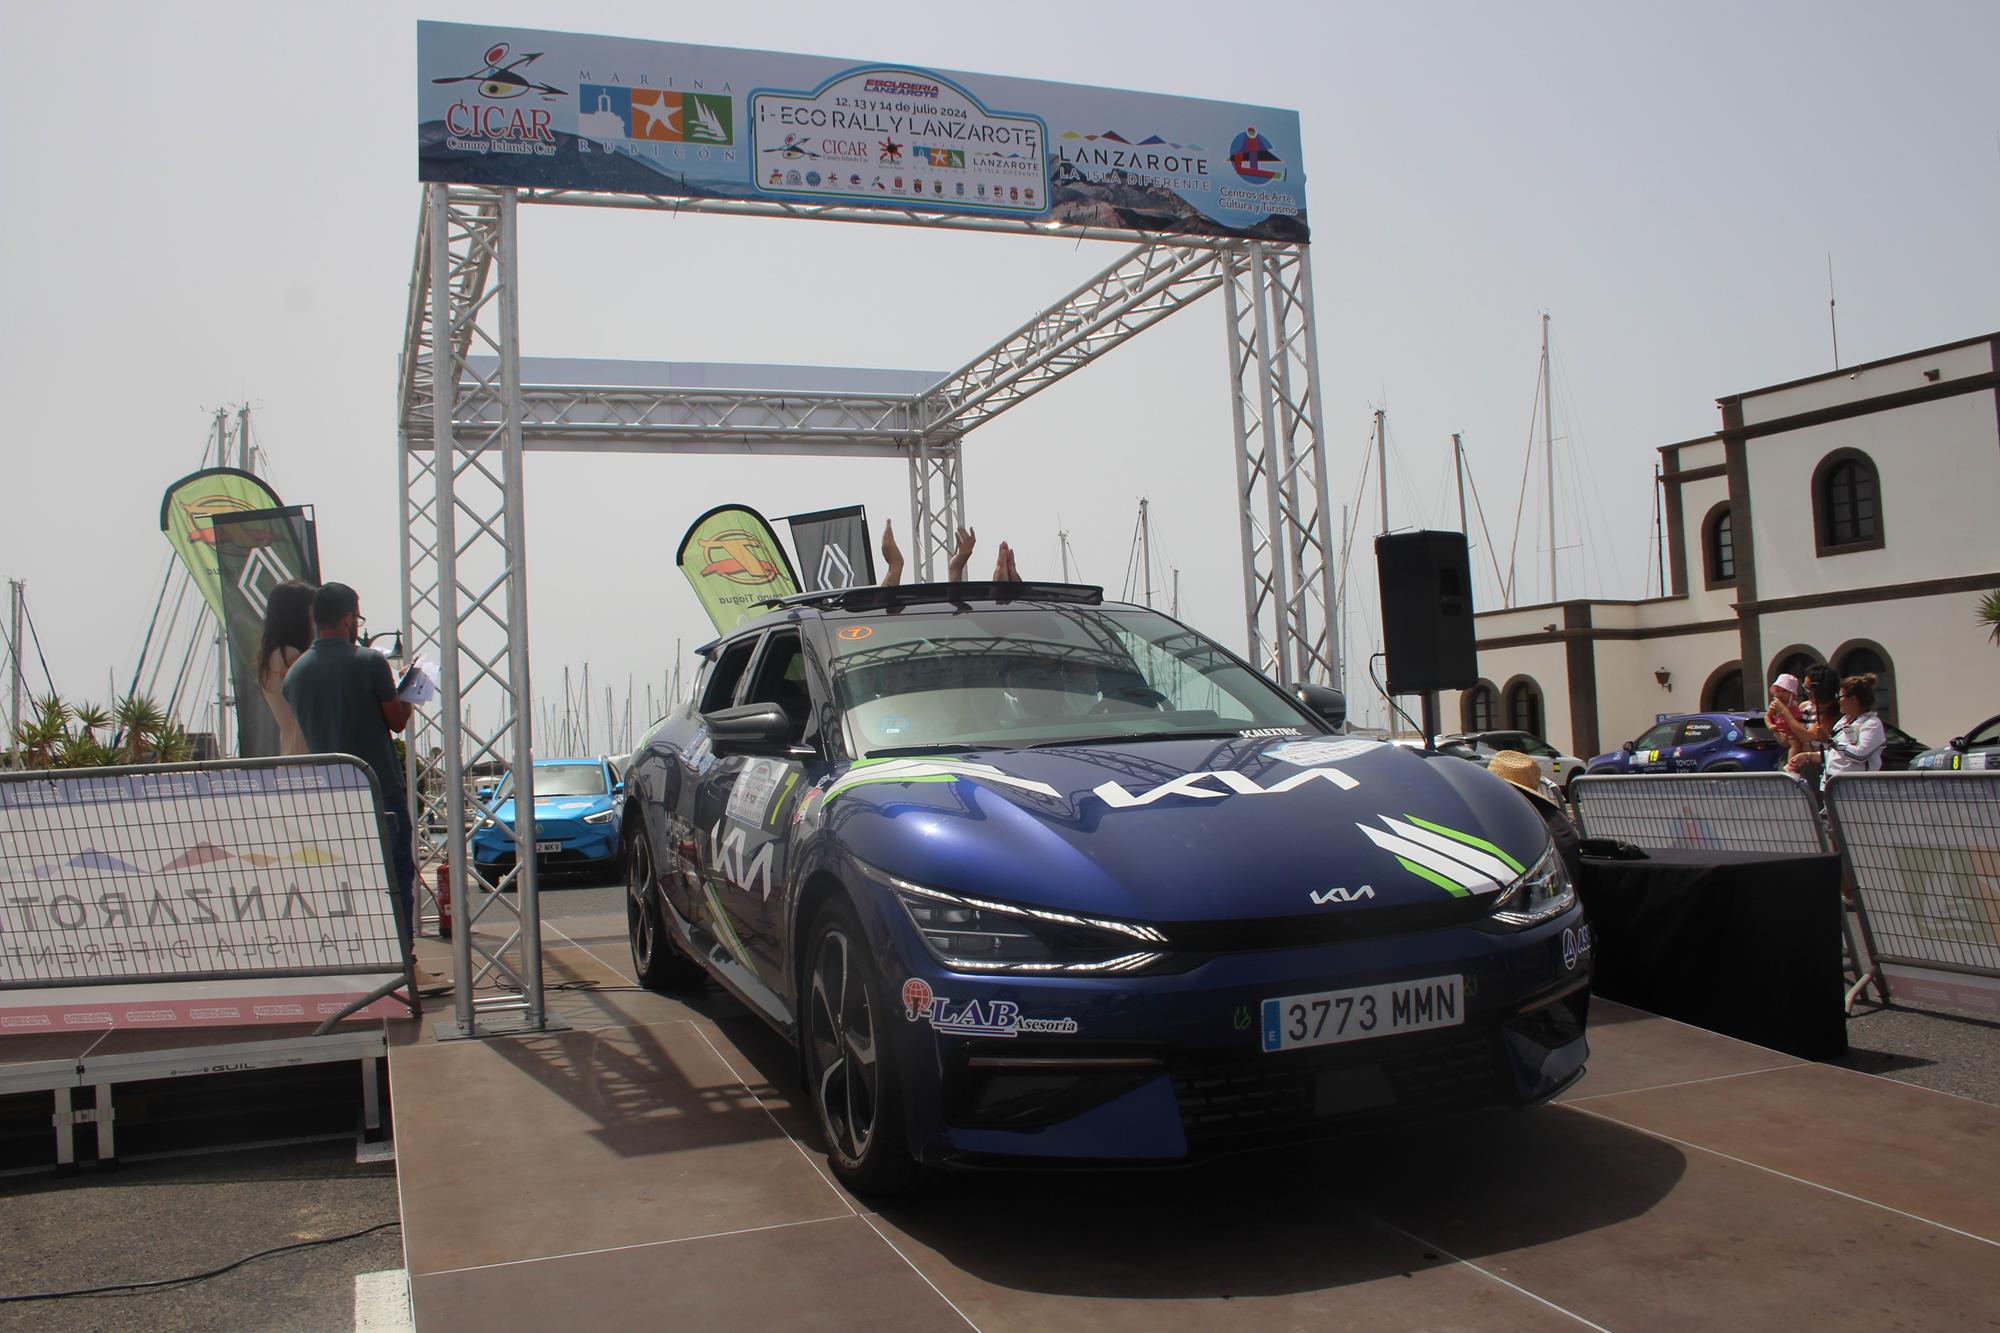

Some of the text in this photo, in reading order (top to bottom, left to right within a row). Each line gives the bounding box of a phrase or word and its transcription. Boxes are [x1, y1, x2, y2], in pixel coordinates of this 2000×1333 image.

[580, 70, 732, 93] MARINA
[865, 79, 939, 92] ESCUDERIA
[864, 86, 938, 98] LANZAROTE
[836, 97, 967, 119] 12, 13 y 14 de julio 2024
[446, 103, 556, 141] CICAR
[832, 110, 903, 133] RALLY
[910, 117, 1036, 146] LANZAROTE
[447, 138, 556, 156] Canary Islands Car
[578, 138, 736, 161] RUBICON
[822, 139, 868, 157] CICAR
[973, 158, 1039, 171] LANZAROTE
[1059, 145, 1208, 175] LANZAROTE
[1060, 166, 1211, 192] LA ISLA DIFERENTE
[1220, 186, 1257, 199] Centros
[1259, 192, 1270, 200] de
[1218, 198, 1297, 215] Cultura y Turismo
[1239, 727, 1302, 739] SCALEXTRIC
[1649, 749, 1659, 762] 19
[1675, 759, 1697, 767] TOYOTA
[1953, 755, 1959, 769] 8
[1093, 768, 1361, 808] KIA
[711, 819, 774, 903] KIA
[1309, 885, 1375, 904] KIA
[1288, 983, 1455, 1041] 3773 MMN
[1268, 1030, 1276, 1042] E
[212, 1063, 256, 1072] GUIL
